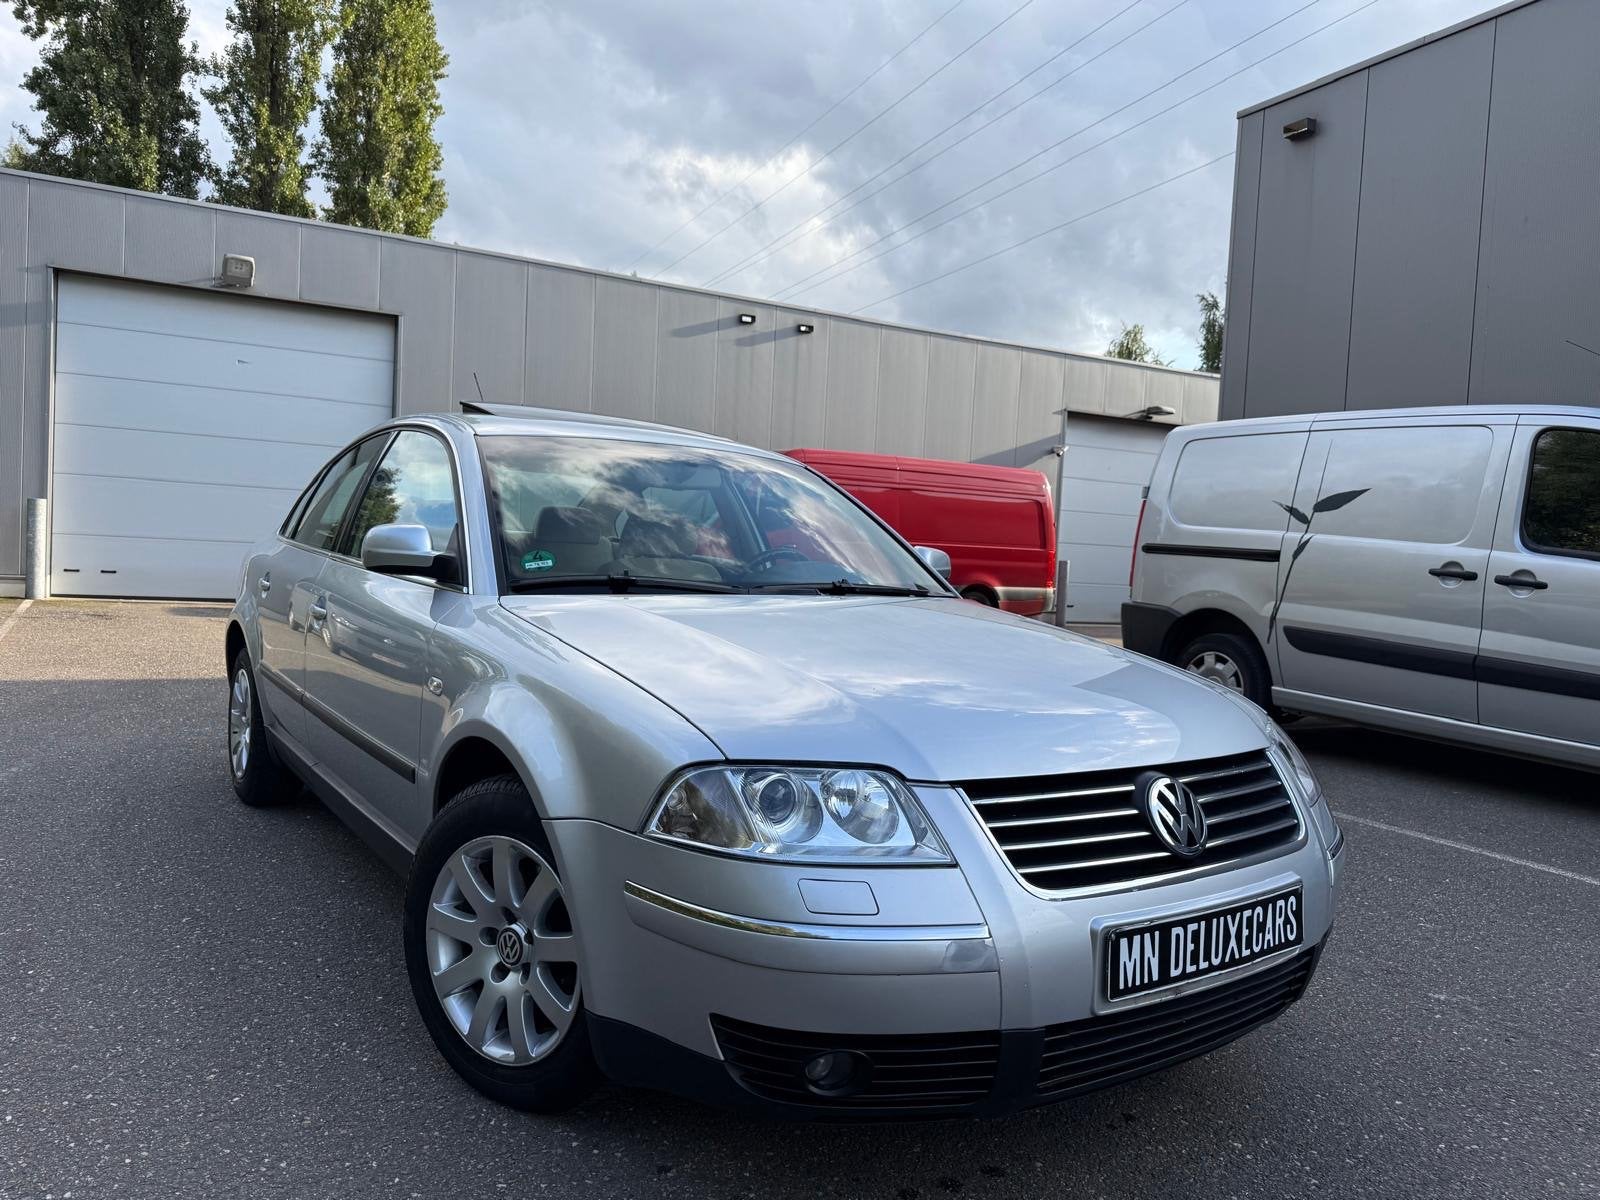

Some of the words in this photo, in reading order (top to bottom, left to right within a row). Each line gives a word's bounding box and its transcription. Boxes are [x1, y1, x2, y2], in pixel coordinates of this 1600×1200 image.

[533, 551, 543, 561] 4
[1148, 777, 1206, 853] VW
[499, 931, 520, 963] VW
[1119, 930, 1160, 990] MN
[1169, 895, 1298, 978] DELUXECARS
